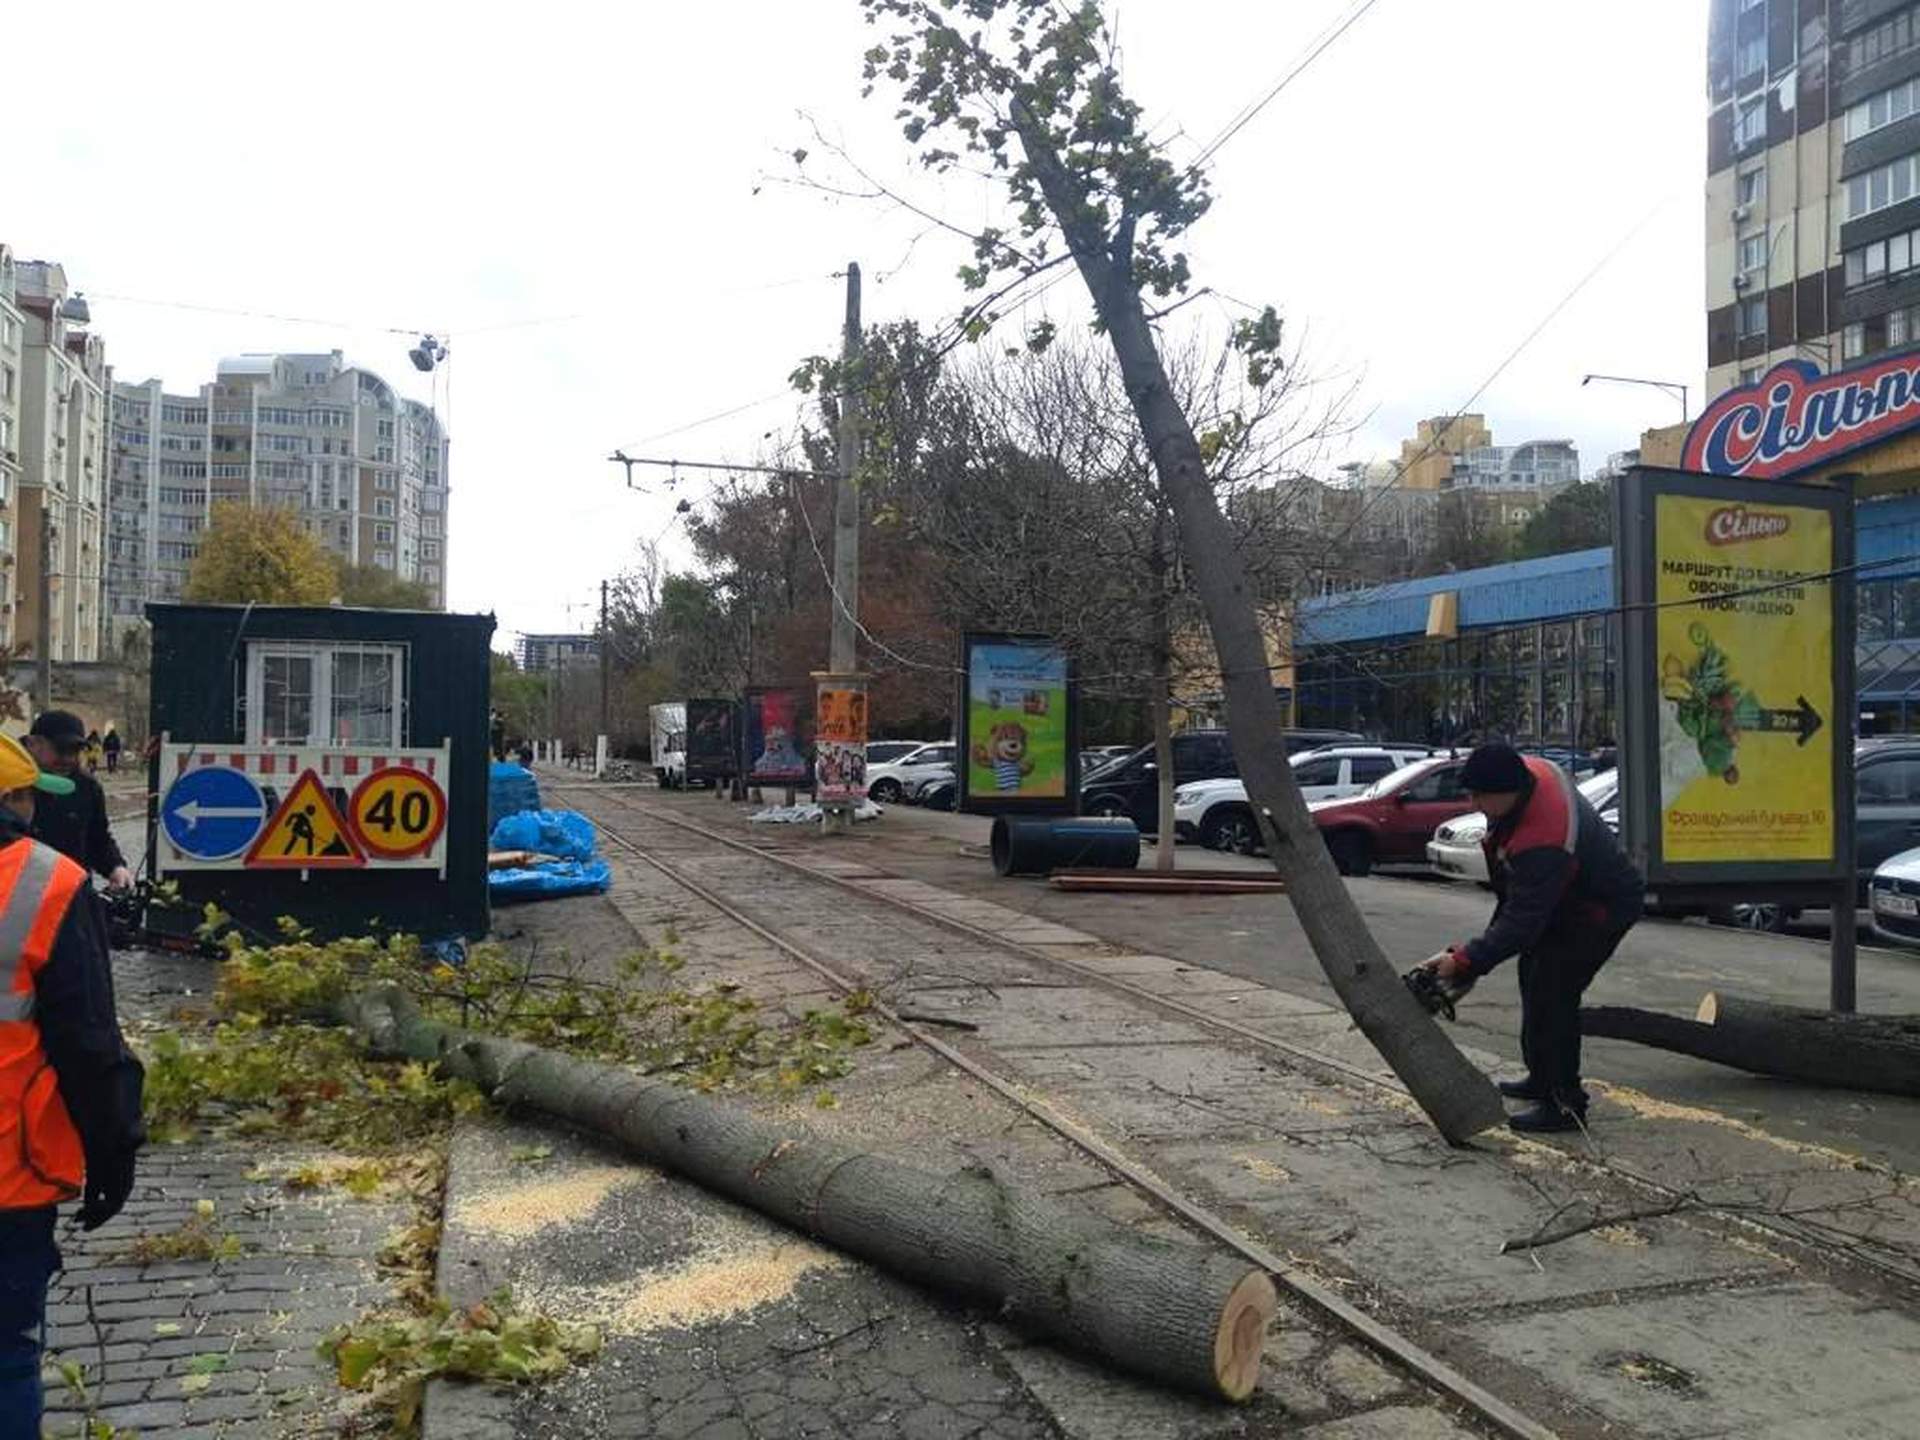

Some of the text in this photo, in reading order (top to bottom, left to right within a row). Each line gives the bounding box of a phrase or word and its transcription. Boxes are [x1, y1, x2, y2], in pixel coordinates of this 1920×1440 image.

[1713, 509, 1787, 539] Сільпо
[1662, 561, 1732, 578] МАРШРУТ
[365, 790, 430, 834] 40
